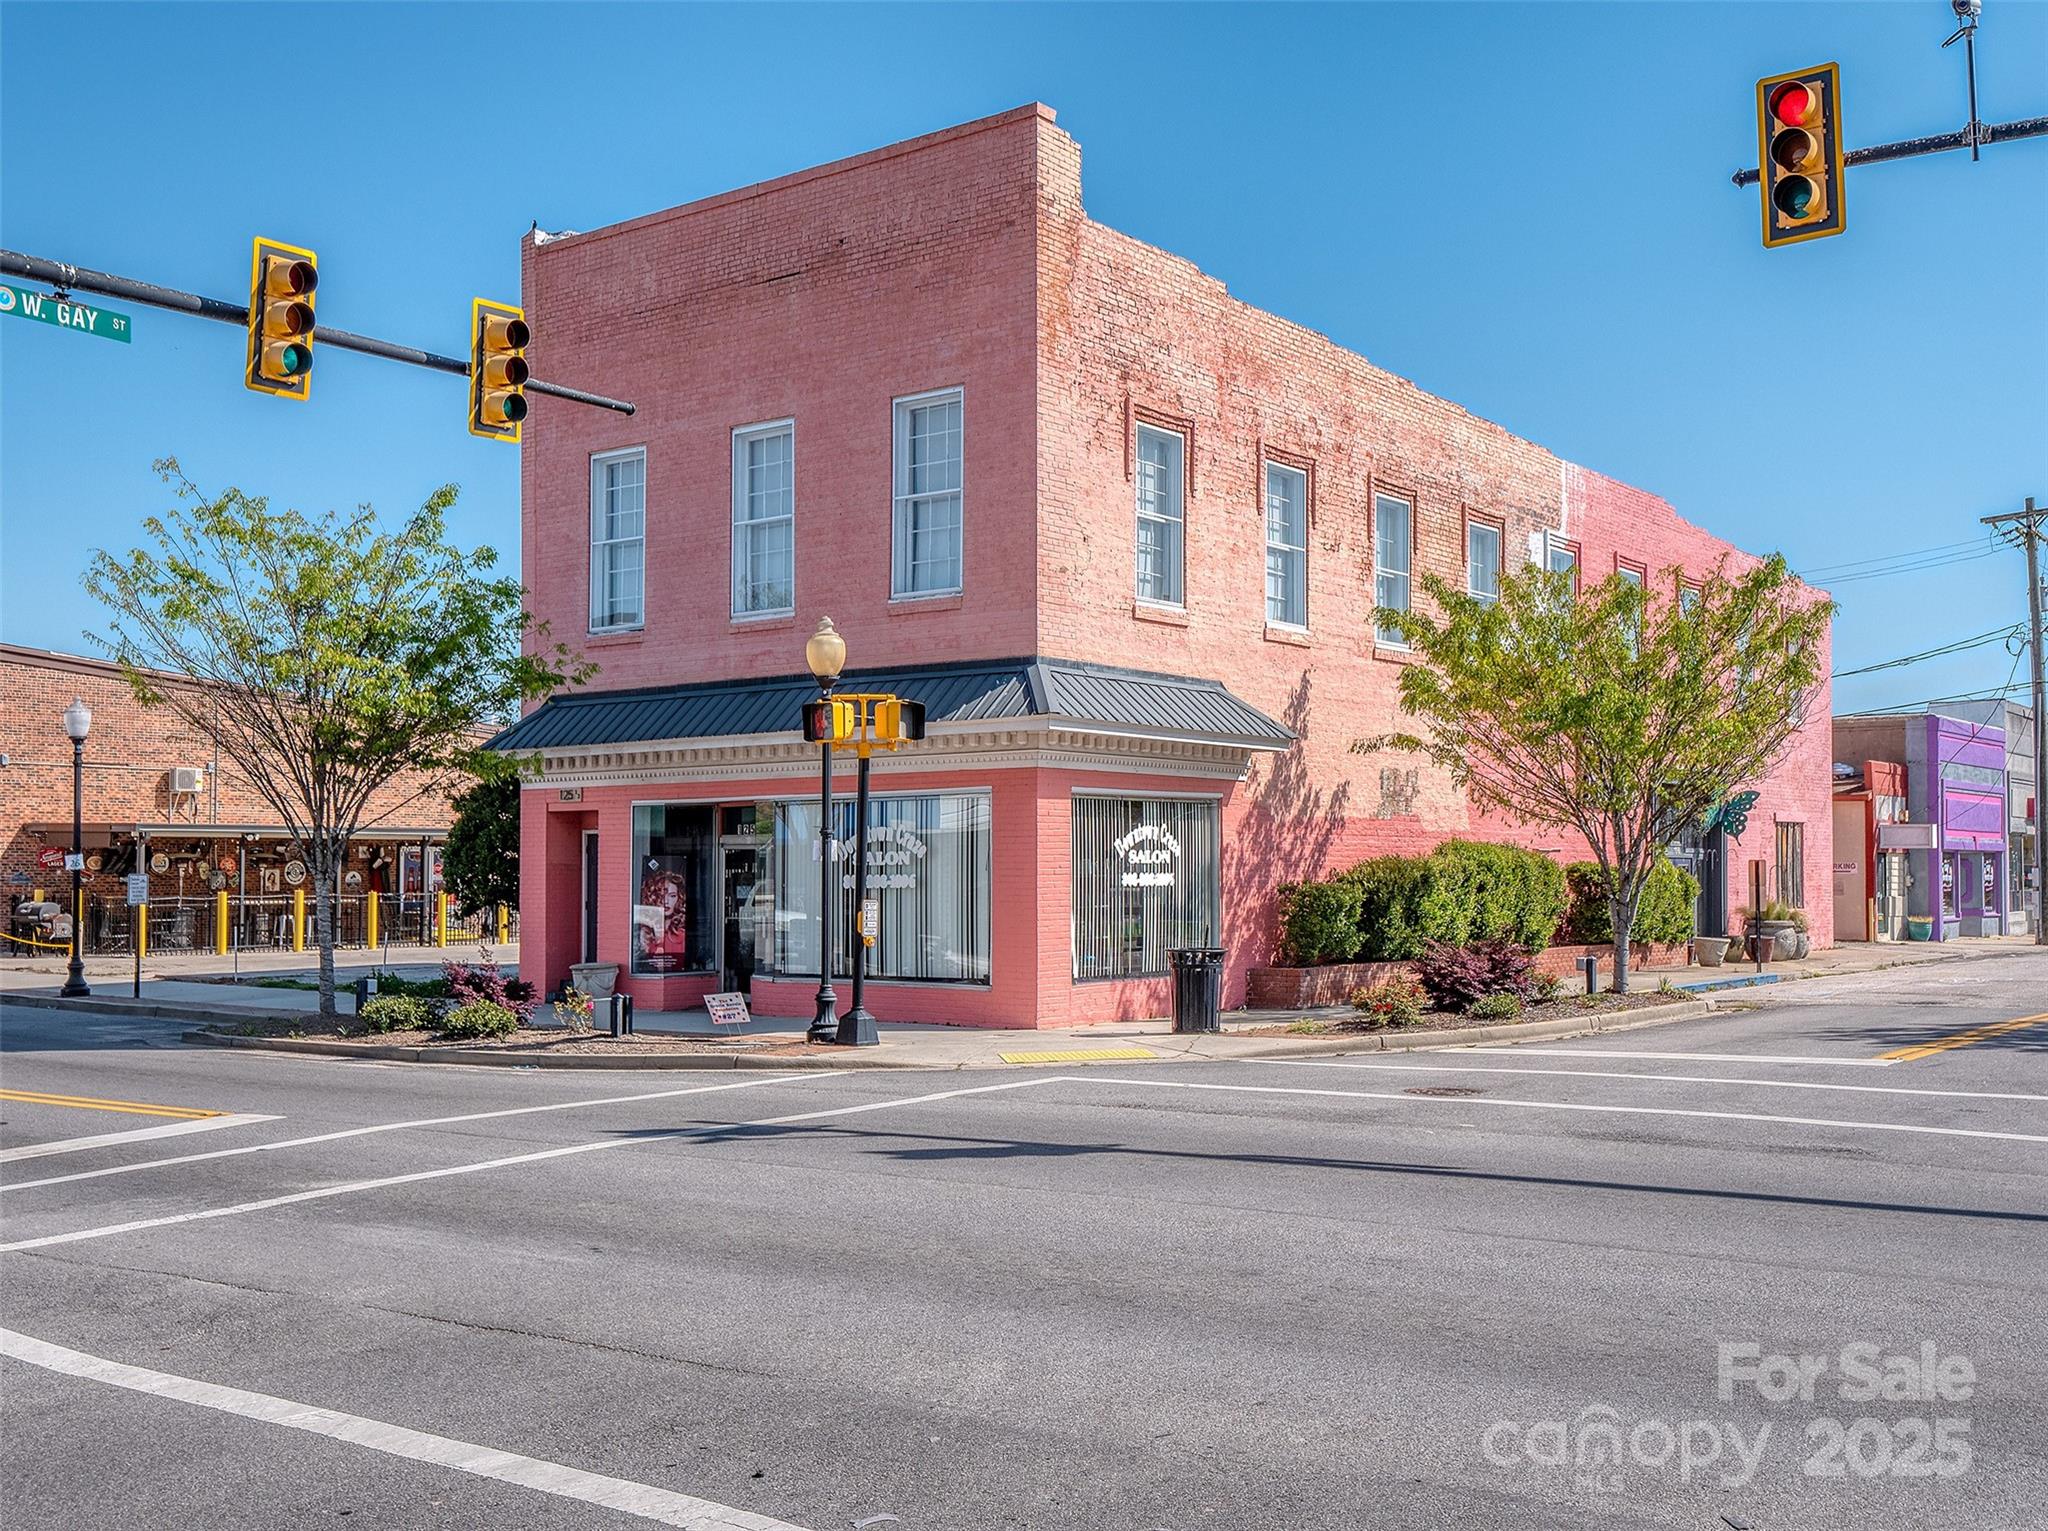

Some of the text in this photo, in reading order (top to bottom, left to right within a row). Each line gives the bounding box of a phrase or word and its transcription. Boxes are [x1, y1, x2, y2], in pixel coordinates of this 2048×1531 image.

[22, 293, 126, 331] W. GAY ST
[560, 789, 574, 801] 125
[837, 825, 894, 862] Dowtown
[1128, 849, 1171, 864] SALON
